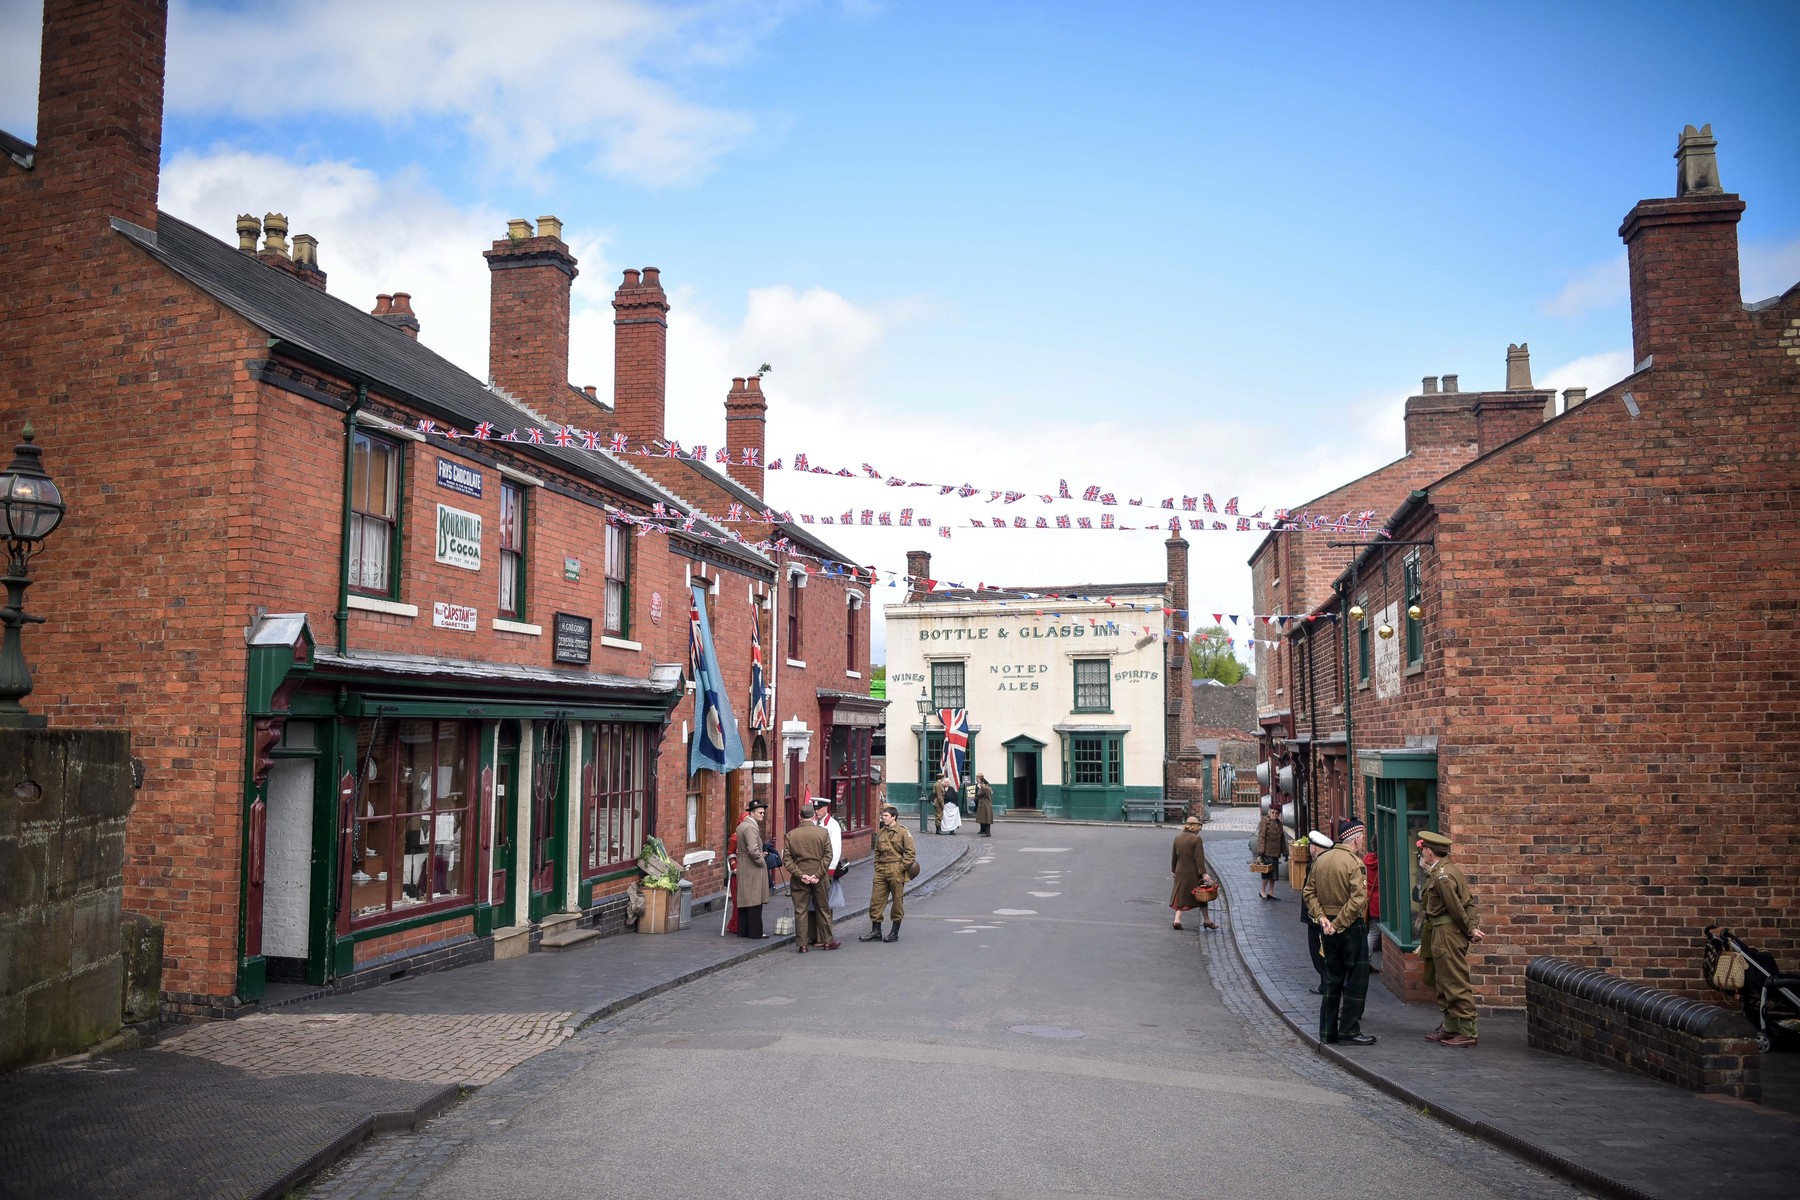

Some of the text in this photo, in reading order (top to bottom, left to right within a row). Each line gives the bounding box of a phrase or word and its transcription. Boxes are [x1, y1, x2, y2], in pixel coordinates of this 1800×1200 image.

[453, 465, 481, 489] CHOCOLATE
[438, 507, 480, 556] BOURNVILLE
[450, 540, 480, 559] COCOA
[441, 620, 470, 629] CIGARETTES
[919, 624, 1120, 641] BOTTLE & GLASS INN
[892, 669, 1159, 683] WINES SPIRITS
[989, 664, 1048, 674] NOTED
[997, 682, 1039, 691] ALES
